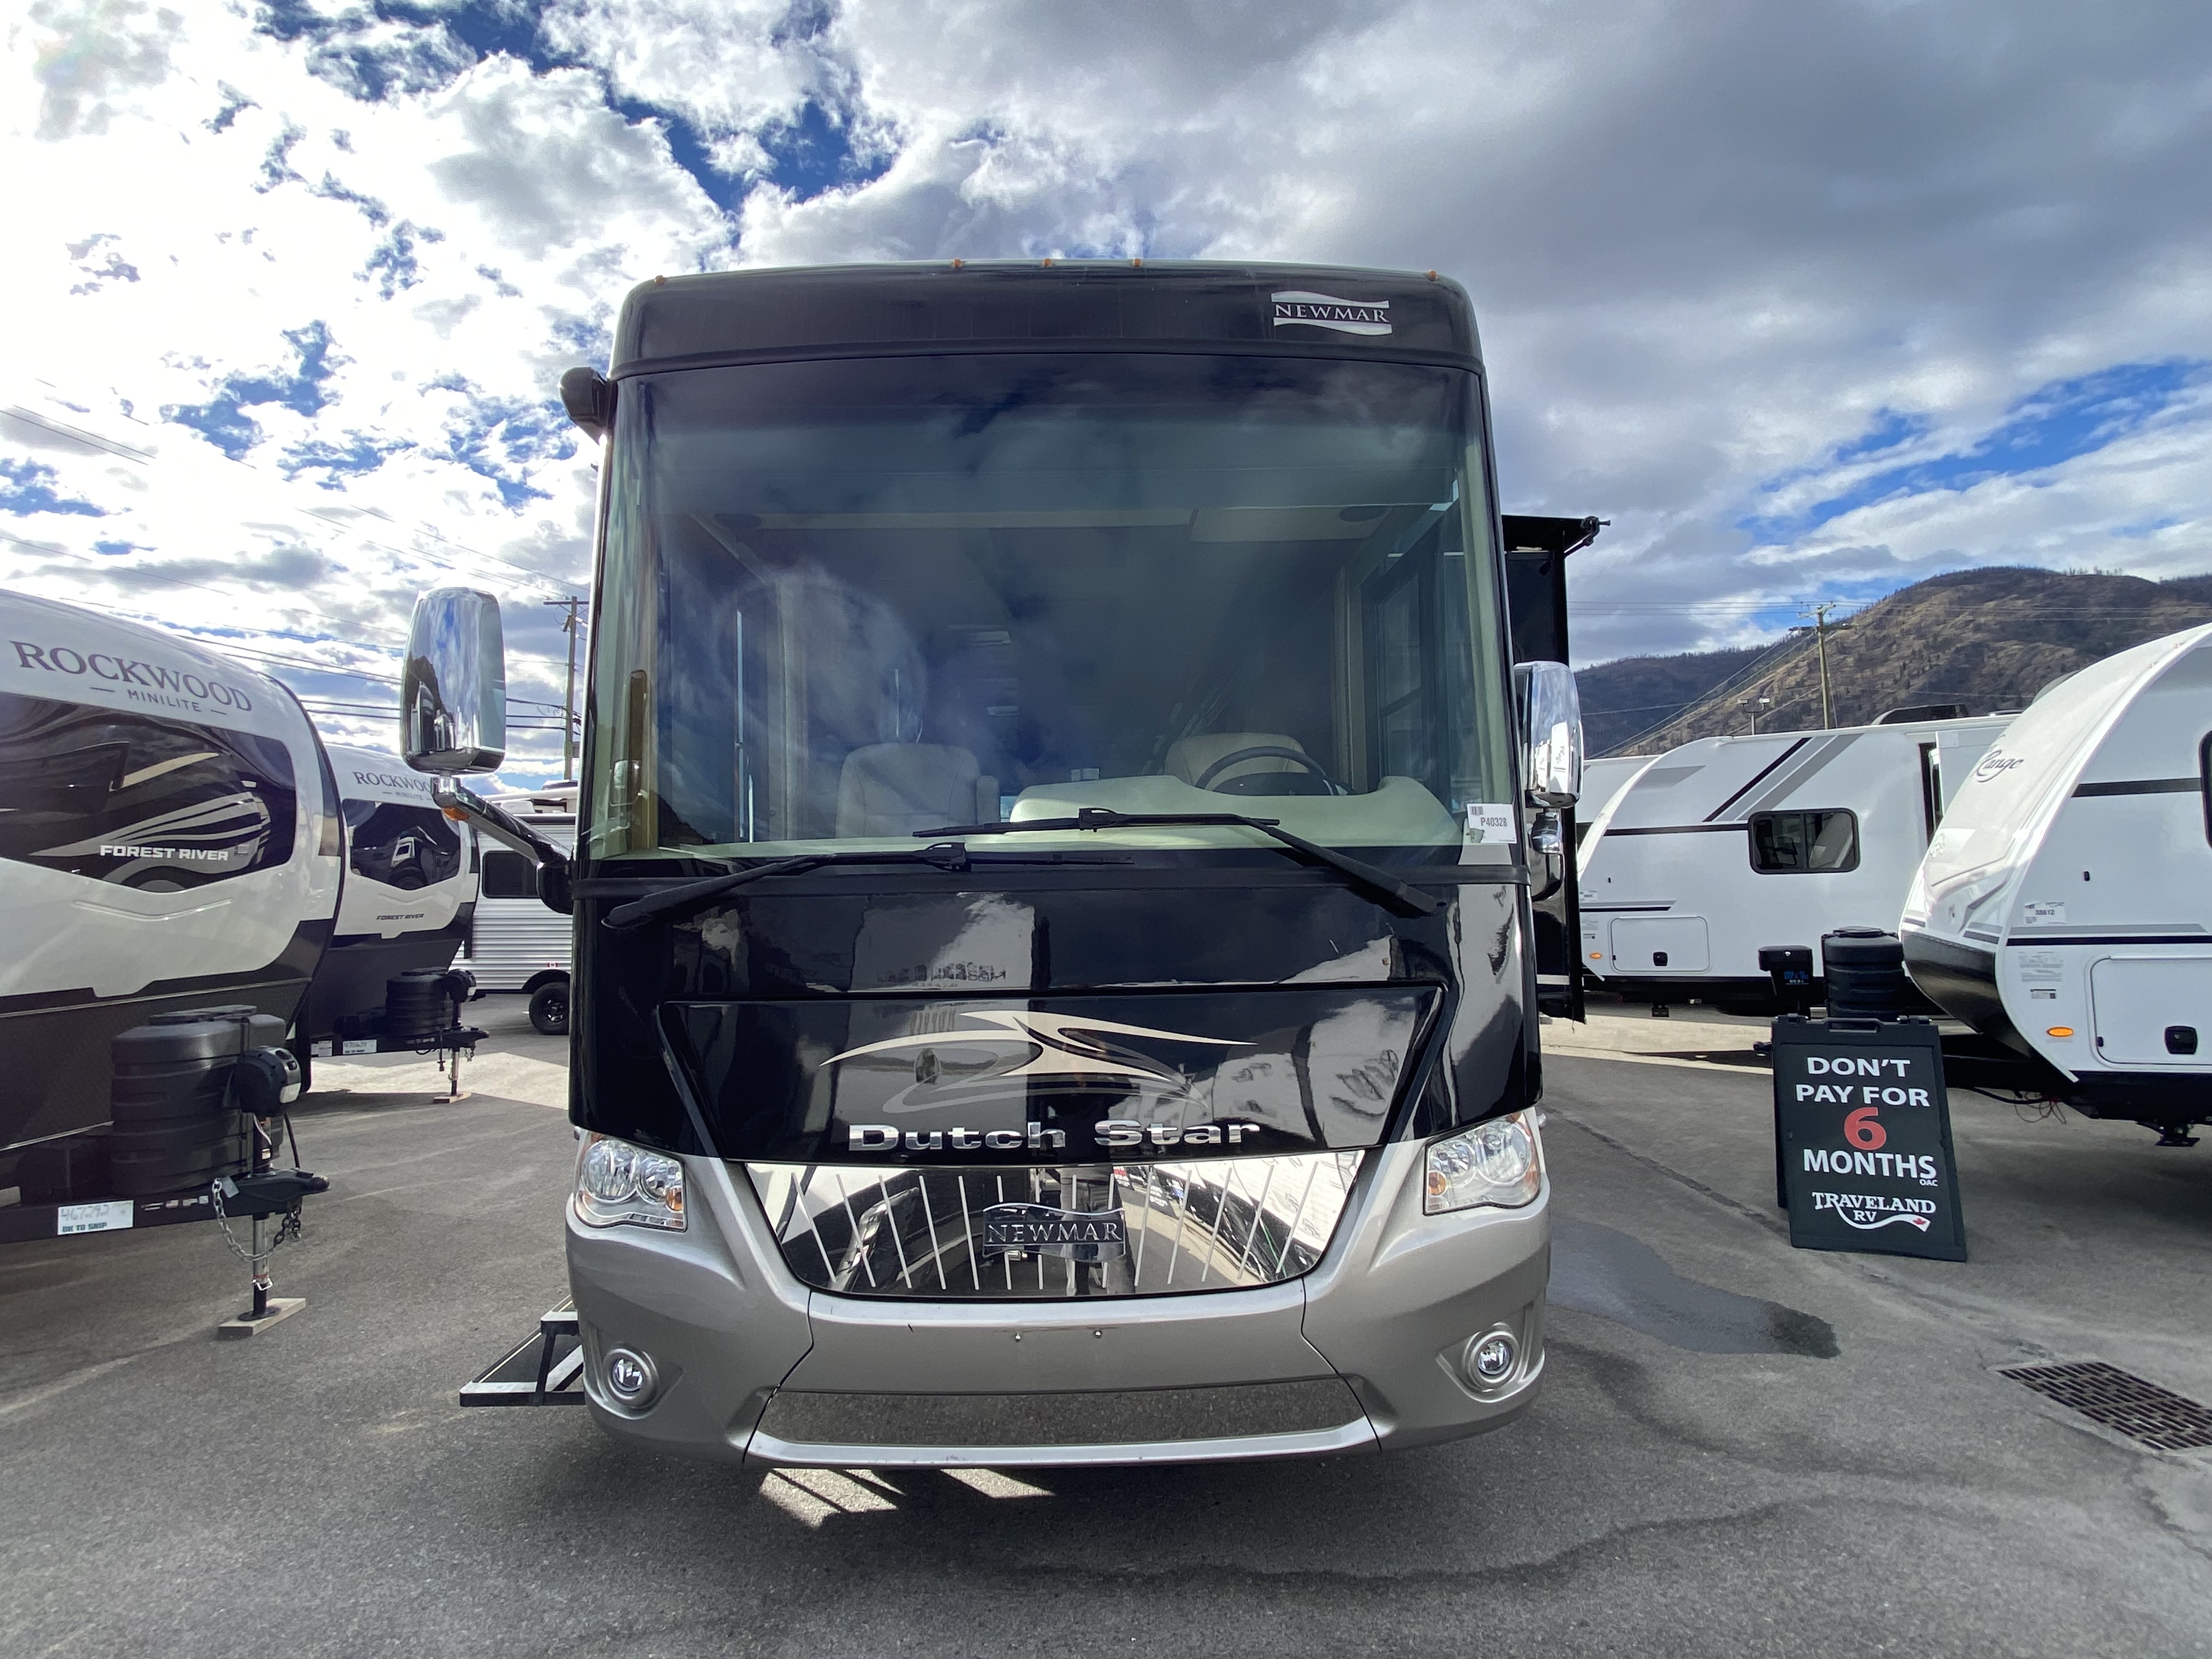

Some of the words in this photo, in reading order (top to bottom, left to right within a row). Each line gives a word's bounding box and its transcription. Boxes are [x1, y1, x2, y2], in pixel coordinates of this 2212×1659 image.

[1275, 303, 1390, 323] NEWMAR
[9, 640, 253, 712] ROCKWOOD
[127, 689, 202, 712] MINILITE
[351, 771, 431, 793] ROCKWOO
[1481, 816, 1508, 827] P40328
[99, 844, 176, 859] FOREST
[178, 848, 228, 861] RIVER
[1807, 1057, 1911, 1077] DON'T
[1796, 1084, 1854, 1104] PAY
[1863, 1086, 1931, 1107] FOR
[849, 1121, 1066, 1151] Dutch
[1094, 1119, 1260, 1146] Star
[1844, 1107, 1887, 1150] 6
[1803, 1149, 1937, 1180] MONTHS
[1812, 1192, 1937, 1214] TRAVELAND
[1853, 1210, 1877, 1222] RV
[987, 1222, 1123, 1243] NEWMAR
